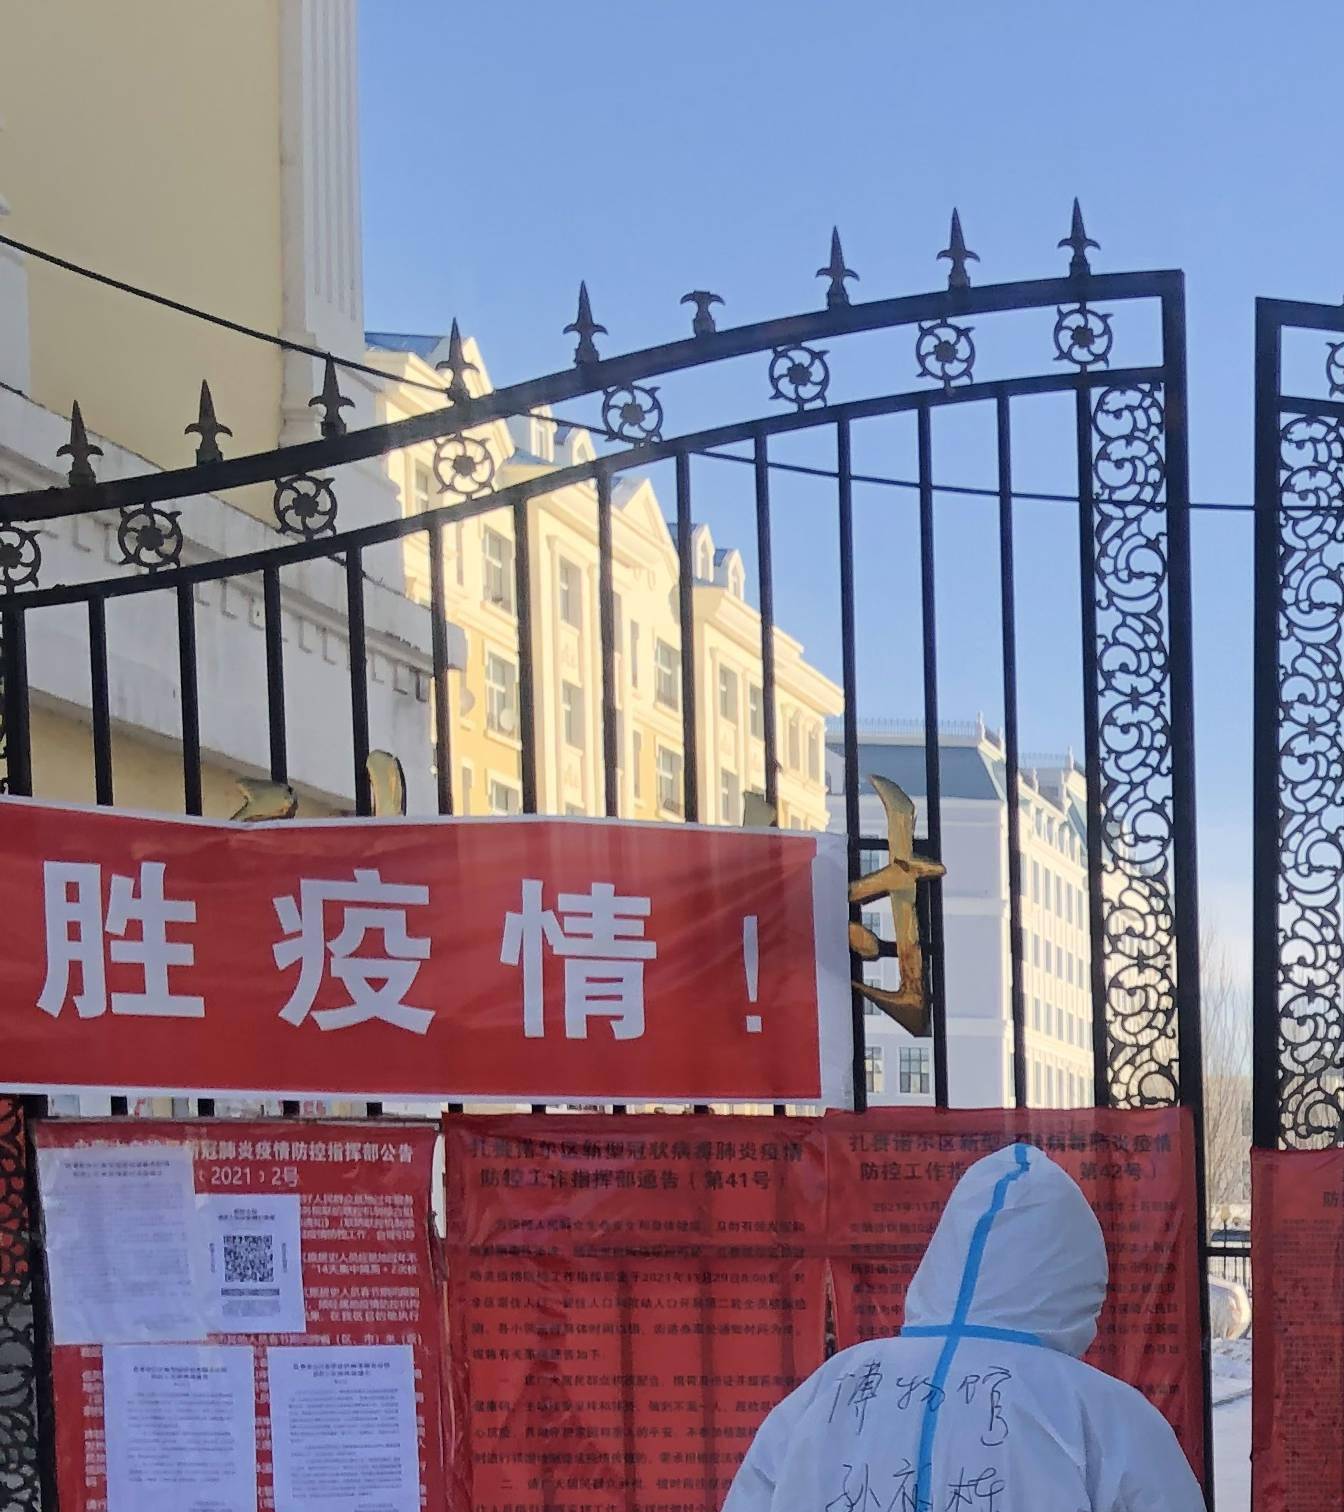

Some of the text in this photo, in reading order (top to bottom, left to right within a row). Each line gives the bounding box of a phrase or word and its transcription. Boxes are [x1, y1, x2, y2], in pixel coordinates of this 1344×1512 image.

[36, 861, 763, 1039] 胜疫情！
[850, 1132, 1171, 1154] 扎赉诺尔区新型病毒肺炎疫情
